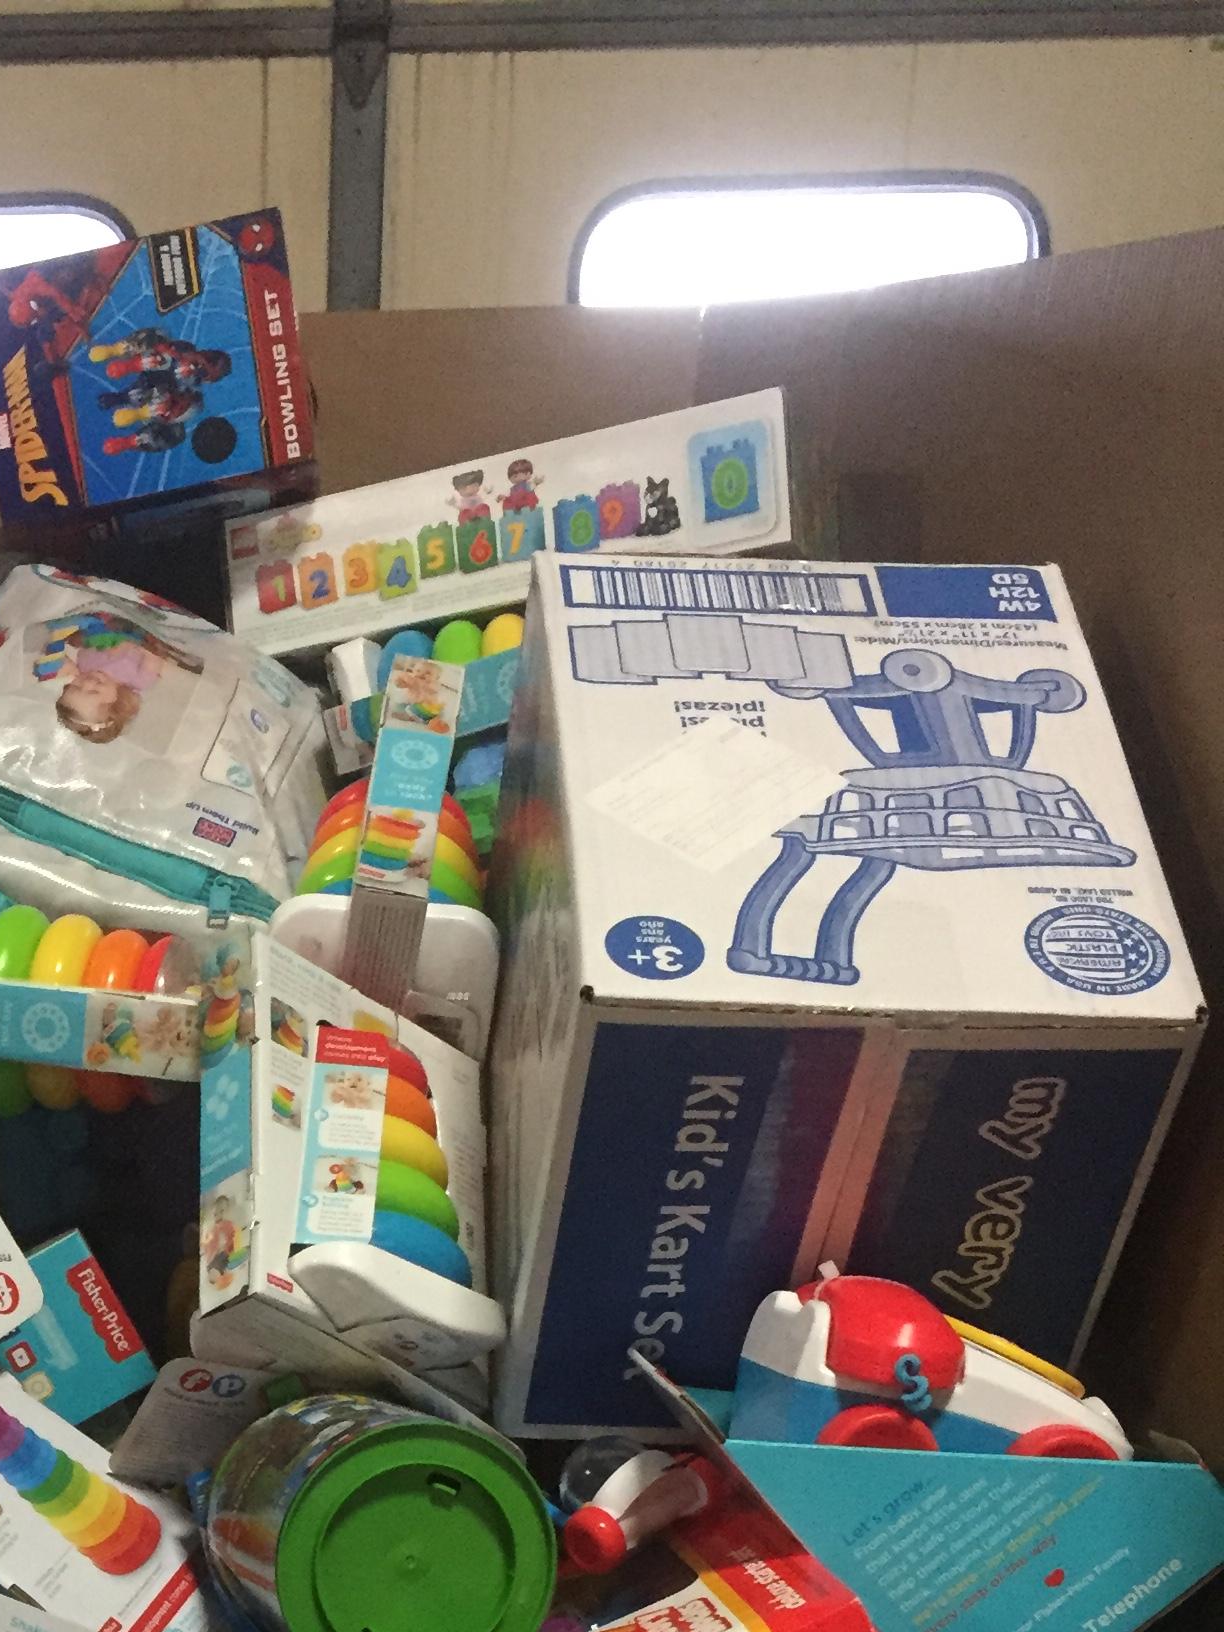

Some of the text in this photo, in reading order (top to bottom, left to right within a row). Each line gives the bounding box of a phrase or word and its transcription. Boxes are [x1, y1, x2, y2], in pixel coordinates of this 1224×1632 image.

[264, 289, 301, 459] BOWLING SET
[308, 569, 330, 598] 2
[348, 555, 369, 588] 3
[386, 556, 413, 590] 4
[426, 537, 445, 570] 5
[468, 531, 492, 565] 6
[506, 521, 525, 557] 7
[602, 498, 623, 534] 9
[628, 945, 683, 972] 3+
[1066, 943, 1117, 953] PLASTIC
[639, 1074, 746, 1299] Kid's Kart
[931, 1076, 1067, 1310] my very
[78, 1268, 131, 1352] Fisher-Price
